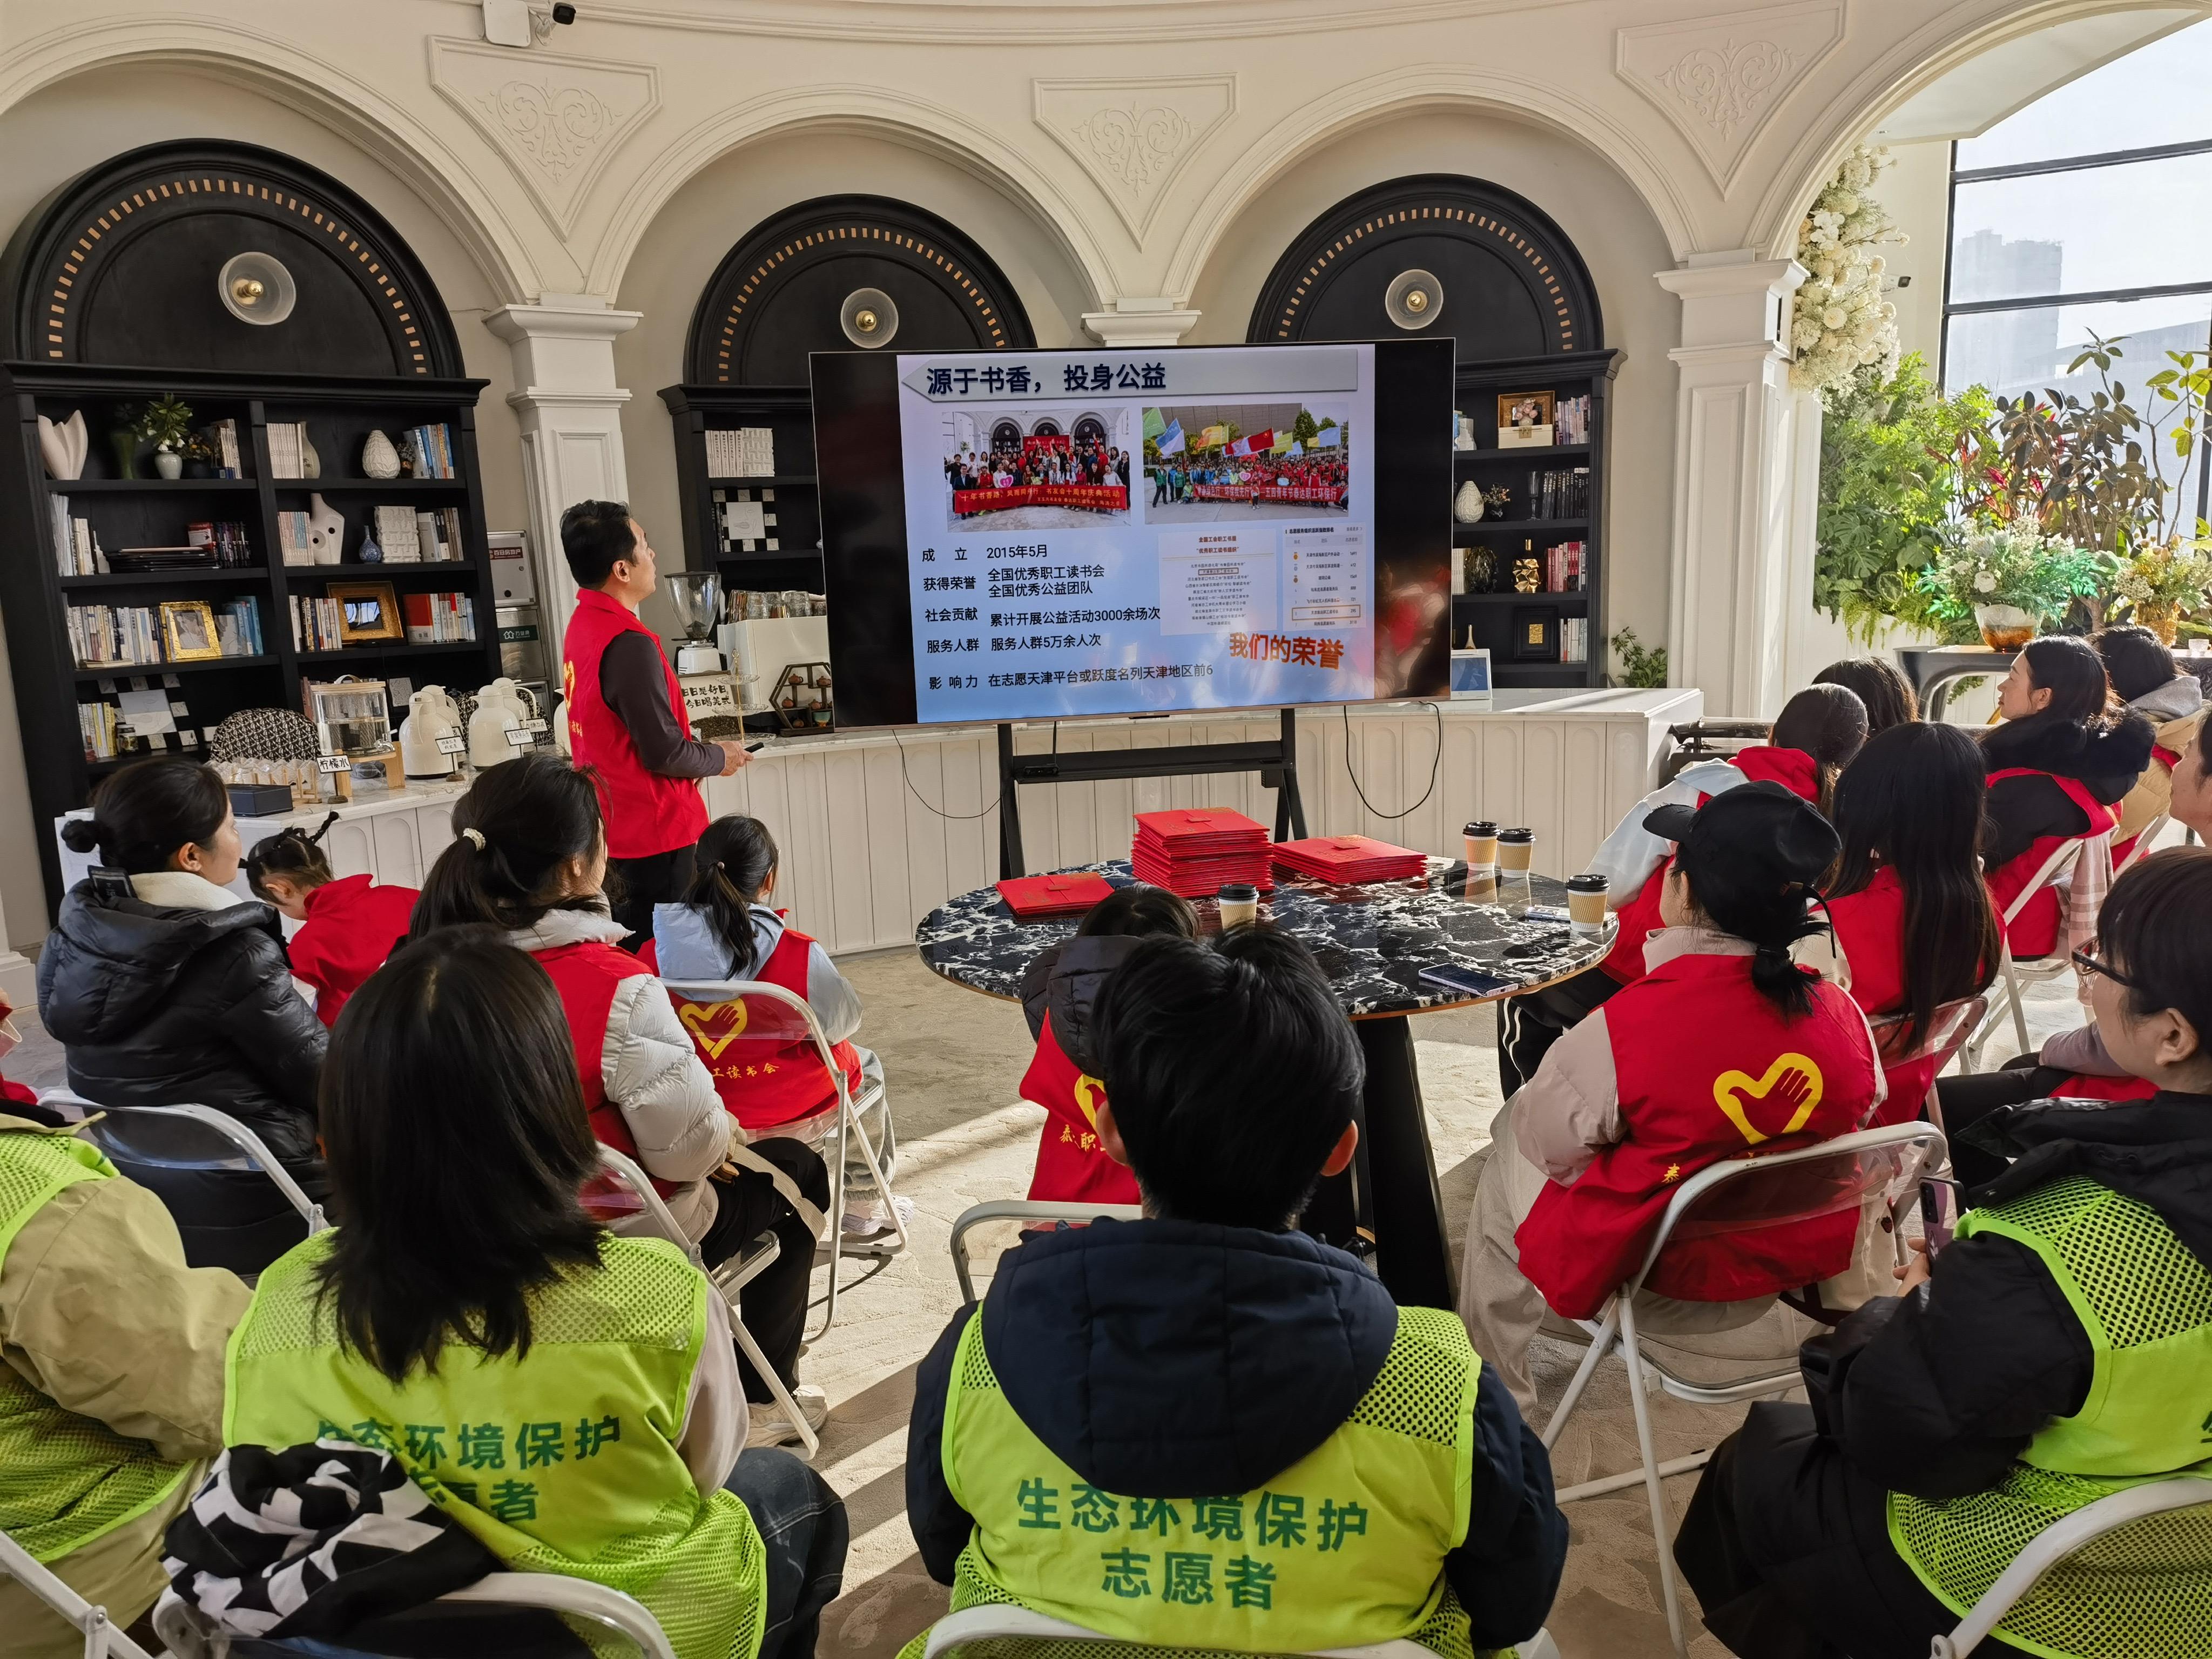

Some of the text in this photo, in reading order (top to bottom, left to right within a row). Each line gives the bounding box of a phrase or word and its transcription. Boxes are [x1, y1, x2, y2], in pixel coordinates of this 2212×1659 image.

[1064, 363, 1166, 392] 投身公益
[986, 544, 1048, 559] 2015年5月
[988, 564, 1105, 582] 全国优秀职工读书会
[923, 576, 1093, 598] 获得荣誉 全国优秀公益团队
[925, 606, 1161, 626] 社会贡献 累计开展公益活动3000余场次
[927, 633, 1101, 653] 服务人群 服务人群5万余人次
[1229, 632, 1344, 670] 我们的荣誉
[988, 664, 1213, 687] 在志愿天津平台或跃度名列天津地区前6
[682, 684, 726, 697] 日日是好日
[686, 696, 731, 709] 今日喝美式
[320, 757, 349, 770] 柠檬水
[1017, 1476, 1368, 1552] 生态环境保护
[1101, 1547, 1277, 1610] 志愿者
